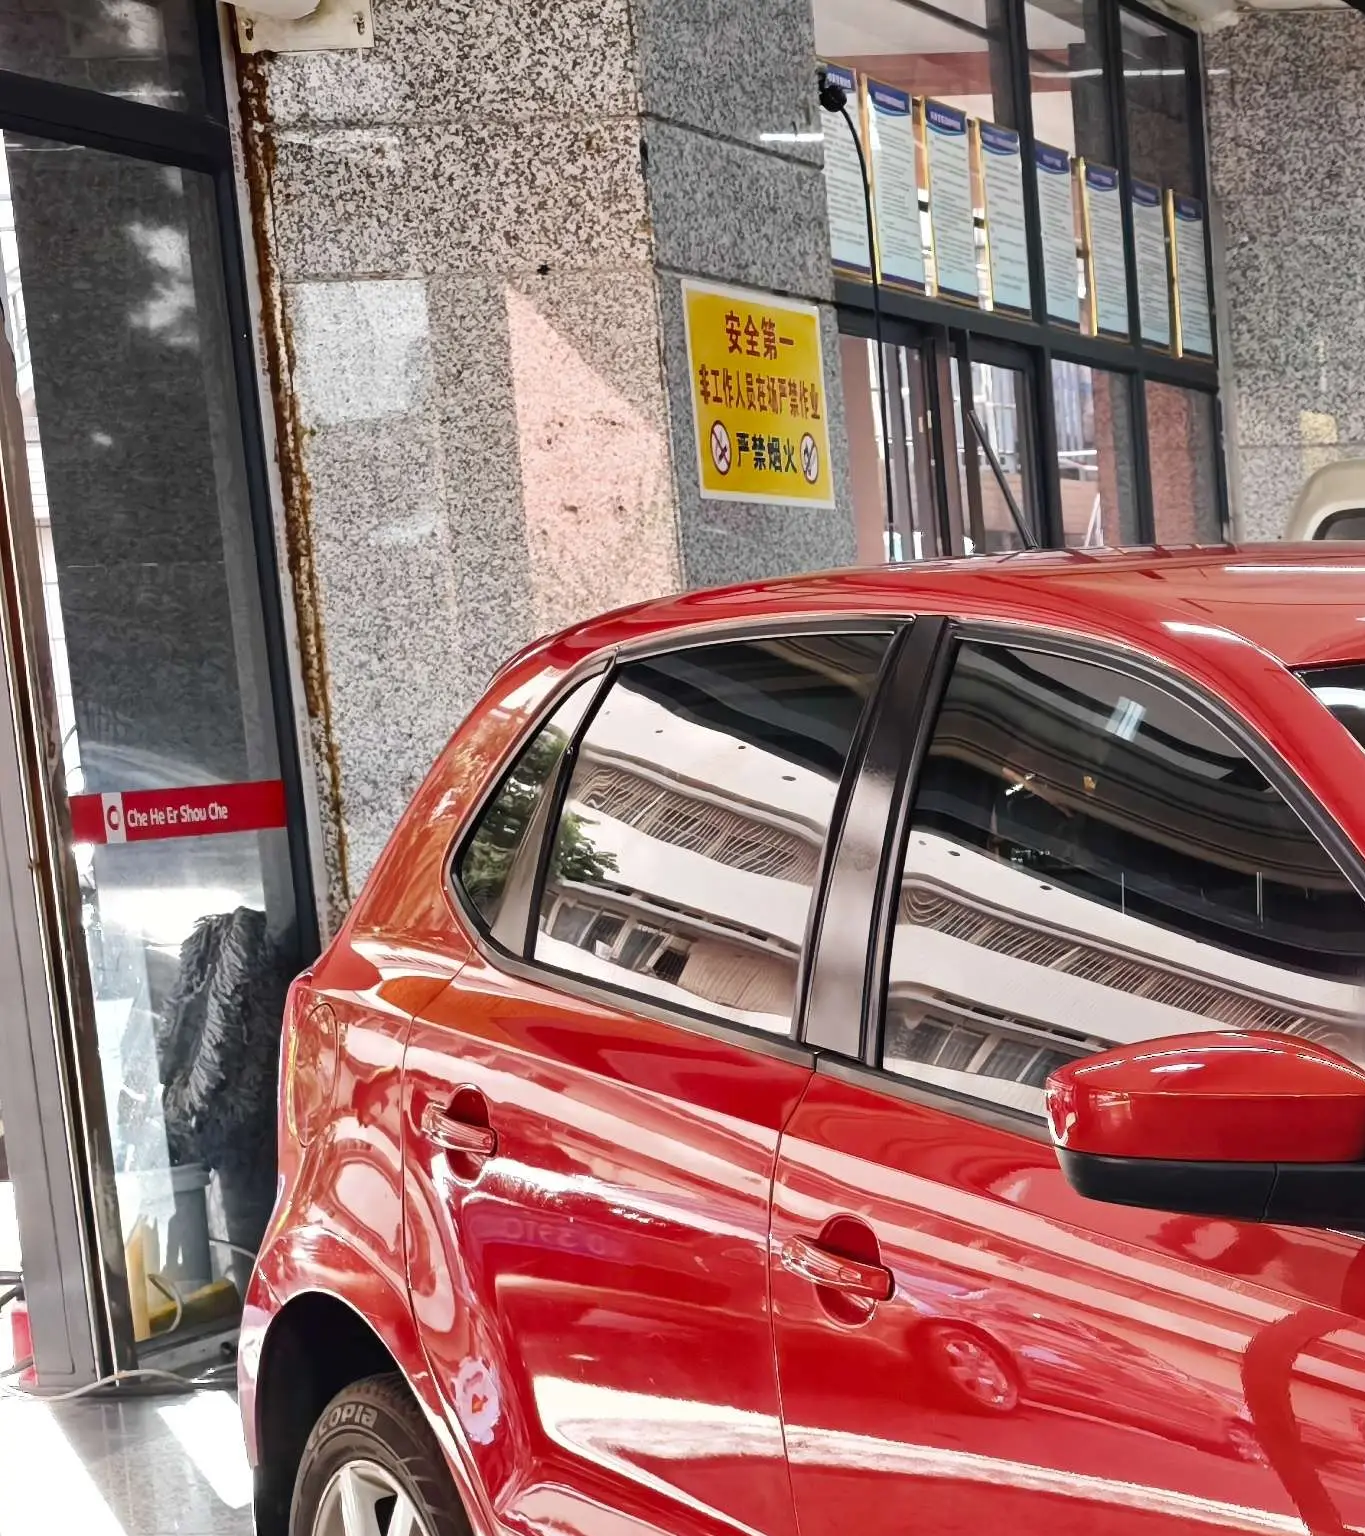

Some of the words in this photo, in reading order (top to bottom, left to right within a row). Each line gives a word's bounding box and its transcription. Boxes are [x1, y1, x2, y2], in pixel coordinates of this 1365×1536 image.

[724, 310, 794, 360] 安全第一
[699, 363, 821, 420] 非工作人员在场严禁作业
[735, 431, 798, 474] 严禁烟火
[127, 809, 148, 828] Che
[150, 807, 165, 825] He
[167, 806, 178, 824] Er
[180, 804, 207, 822] Shou
[209, 802, 228, 820] Che
